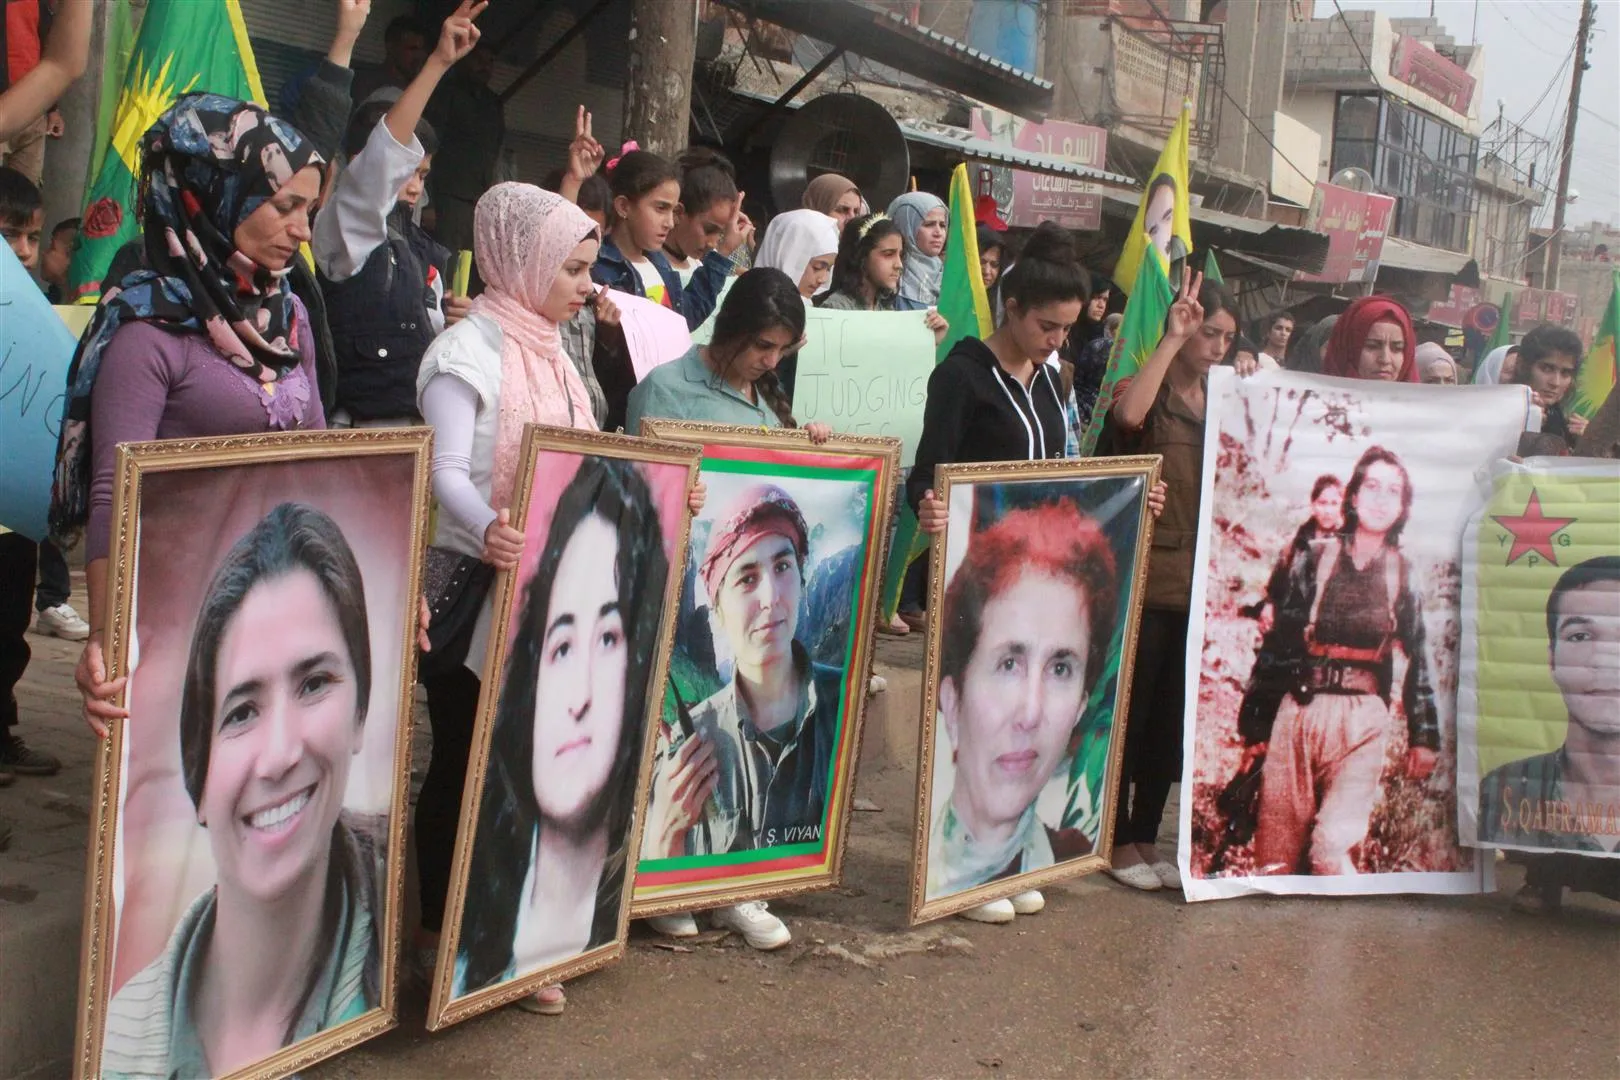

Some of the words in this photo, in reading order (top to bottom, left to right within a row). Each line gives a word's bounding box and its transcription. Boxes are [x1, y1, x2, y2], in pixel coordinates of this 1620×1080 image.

[801, 372, 926, 419] JUDGING
[1496, 534, 1508, 547] Y
[1528, 555, 1540, 569] P
[1557, 533, 1572, 548] G
[784, 824, 822, 842] VIYAN
